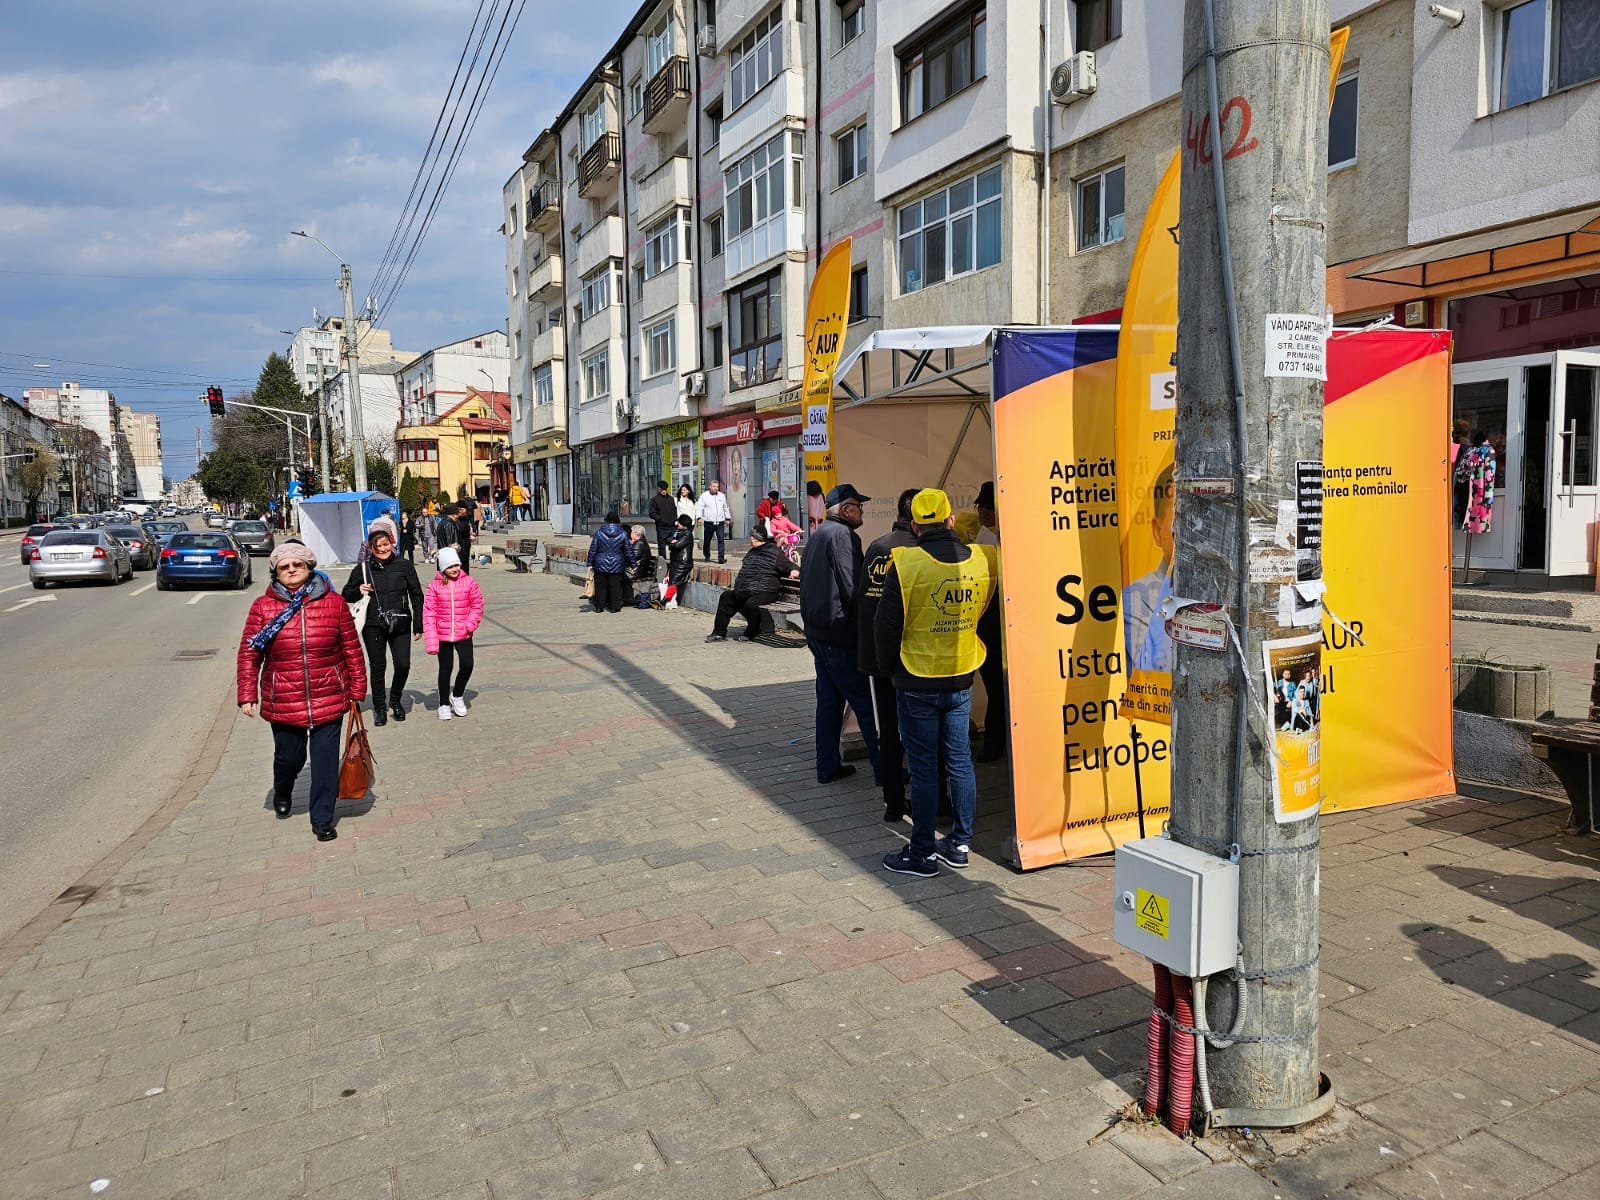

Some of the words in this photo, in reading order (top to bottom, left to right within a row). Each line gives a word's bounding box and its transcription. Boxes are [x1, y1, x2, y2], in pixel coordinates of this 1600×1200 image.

[1186, 96, 1258, 173] 402
[816, 333, 839, 355] AUR
[1278, 361, 1300, 372] 0737
[1302, 362, 1314, 373] 149
[1322, 465, 1352, 483] ianța
[1355, 465, 1392, 481] pentru
[1051, 482, 1116, 505] Patriei
[1352, 481, 1408, 496] Românilor
[1050, 511, 1070, 531] în
[873, 564, 887, 575] AU
[944, 589, 973, 604] AUR
[1058, 648, 1122, 680] lista
[1137, 698, 1150, 712] din
[1065, 739, 1171, 773] Europe
